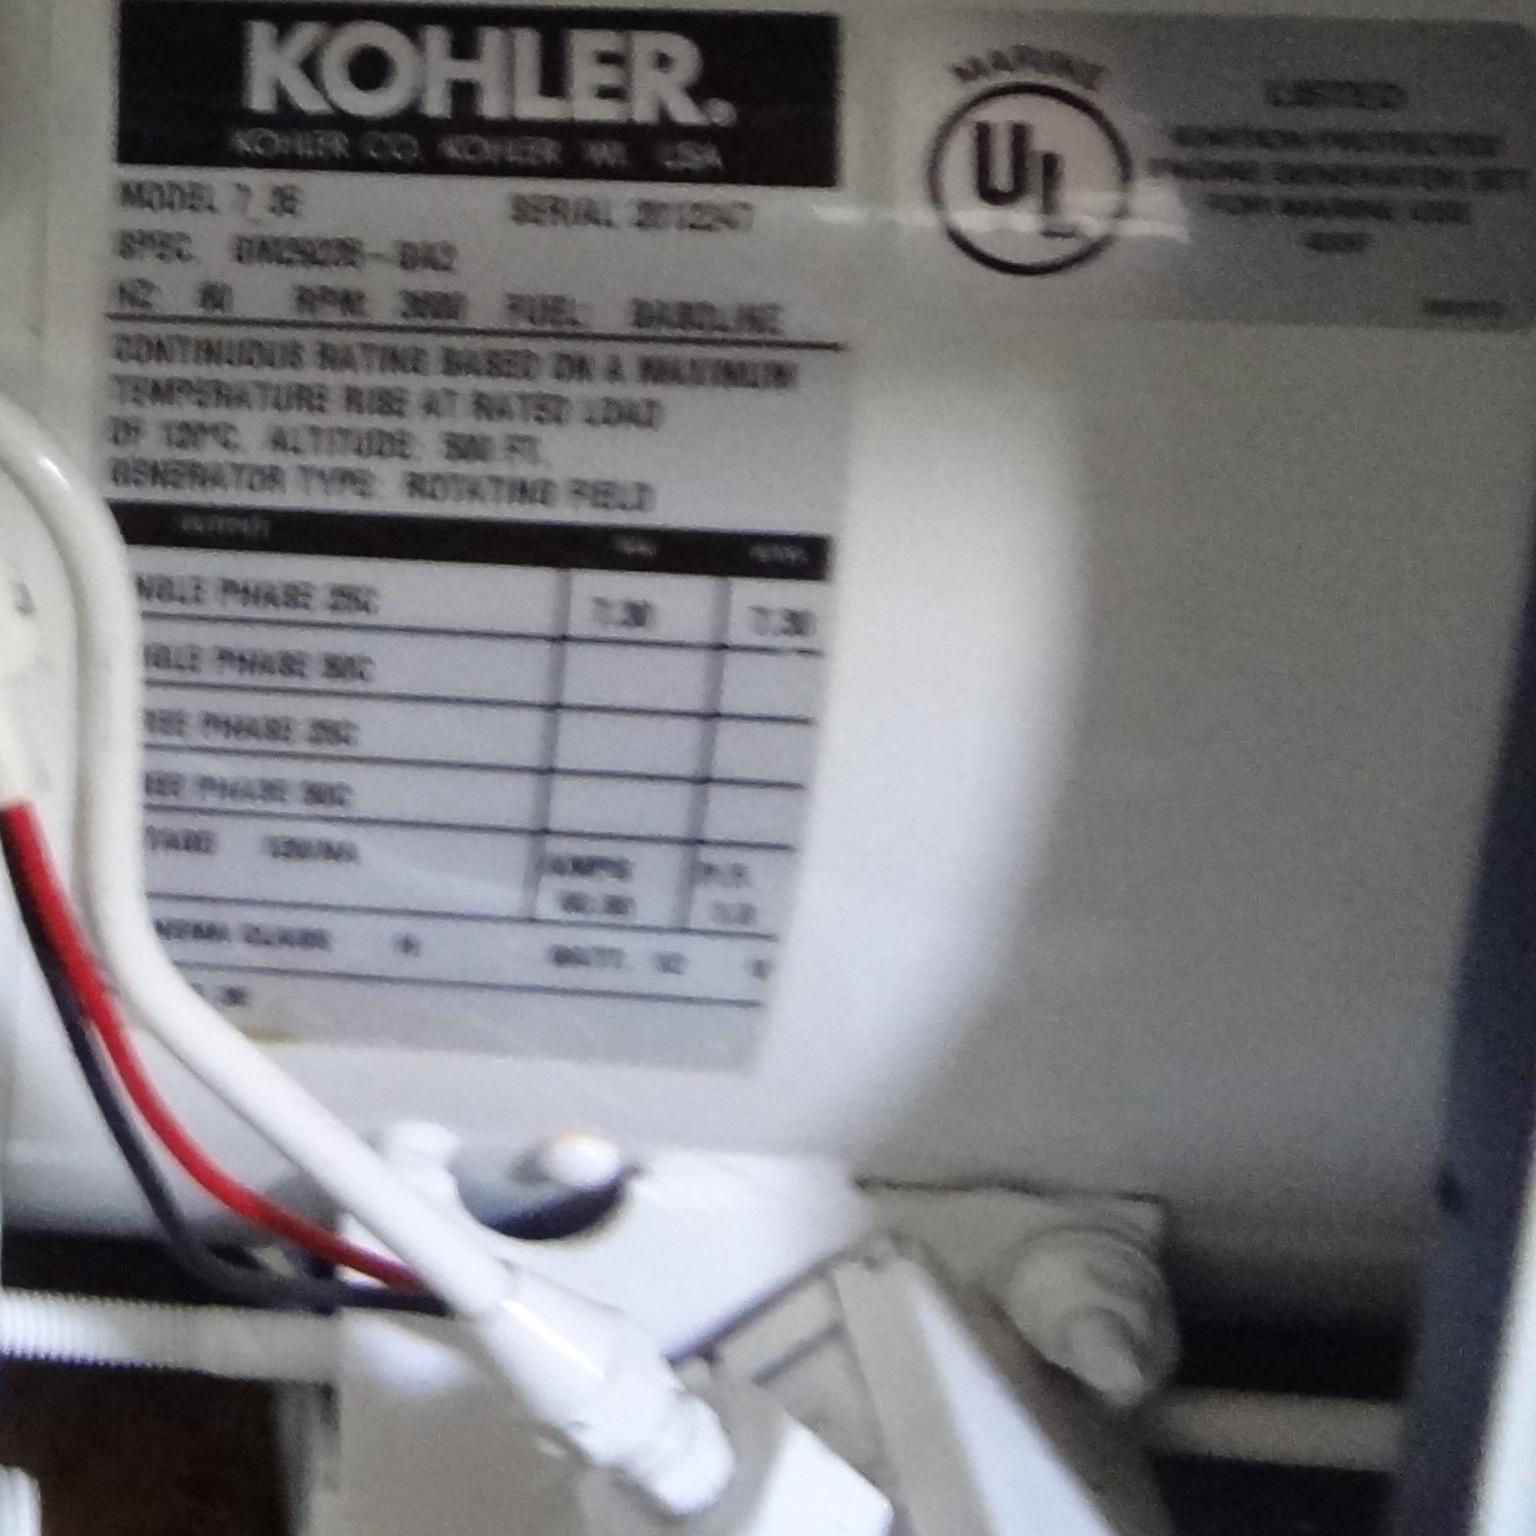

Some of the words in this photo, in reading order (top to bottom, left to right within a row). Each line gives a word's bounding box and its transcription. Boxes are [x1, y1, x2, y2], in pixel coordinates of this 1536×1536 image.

[232, 127, 349, 161] KOHLER
[438, 132, 563, 164] KOHLER
[118, 179, 217, 215] MODEL
[509, 191, 618, 229] SERIAL
[112, 333, 304, 372] CONTINUOUS
[317, 340, 429, 376] RATING
[441, 344, 538, 380] BASED
[552, 349, 598, 383] ON
[605, 352, 626, 383] A
[637, 352, 801, 390] MAXIMUM
[110, 372, 328, 416] TEMPERATURE
[343, 382, 409, 419] RISE
[421, 387, 459, 421] AT
[471, 389, 573, 427] RATED
[583, 394, 665, 431] LOAD
[108, 415, 144, 449] OF
[108, 456, 287, 498] GENERATOR
[406, 469, 557, 509] ROTATING
[569, 475, 656, 514] FIELD
[218, 577, 316, 614] PHASE
[214, 645, 308, 681] PHASE
[200, 708, 295, 745] PHASE
[196, 772, 290, 807] PHASE
